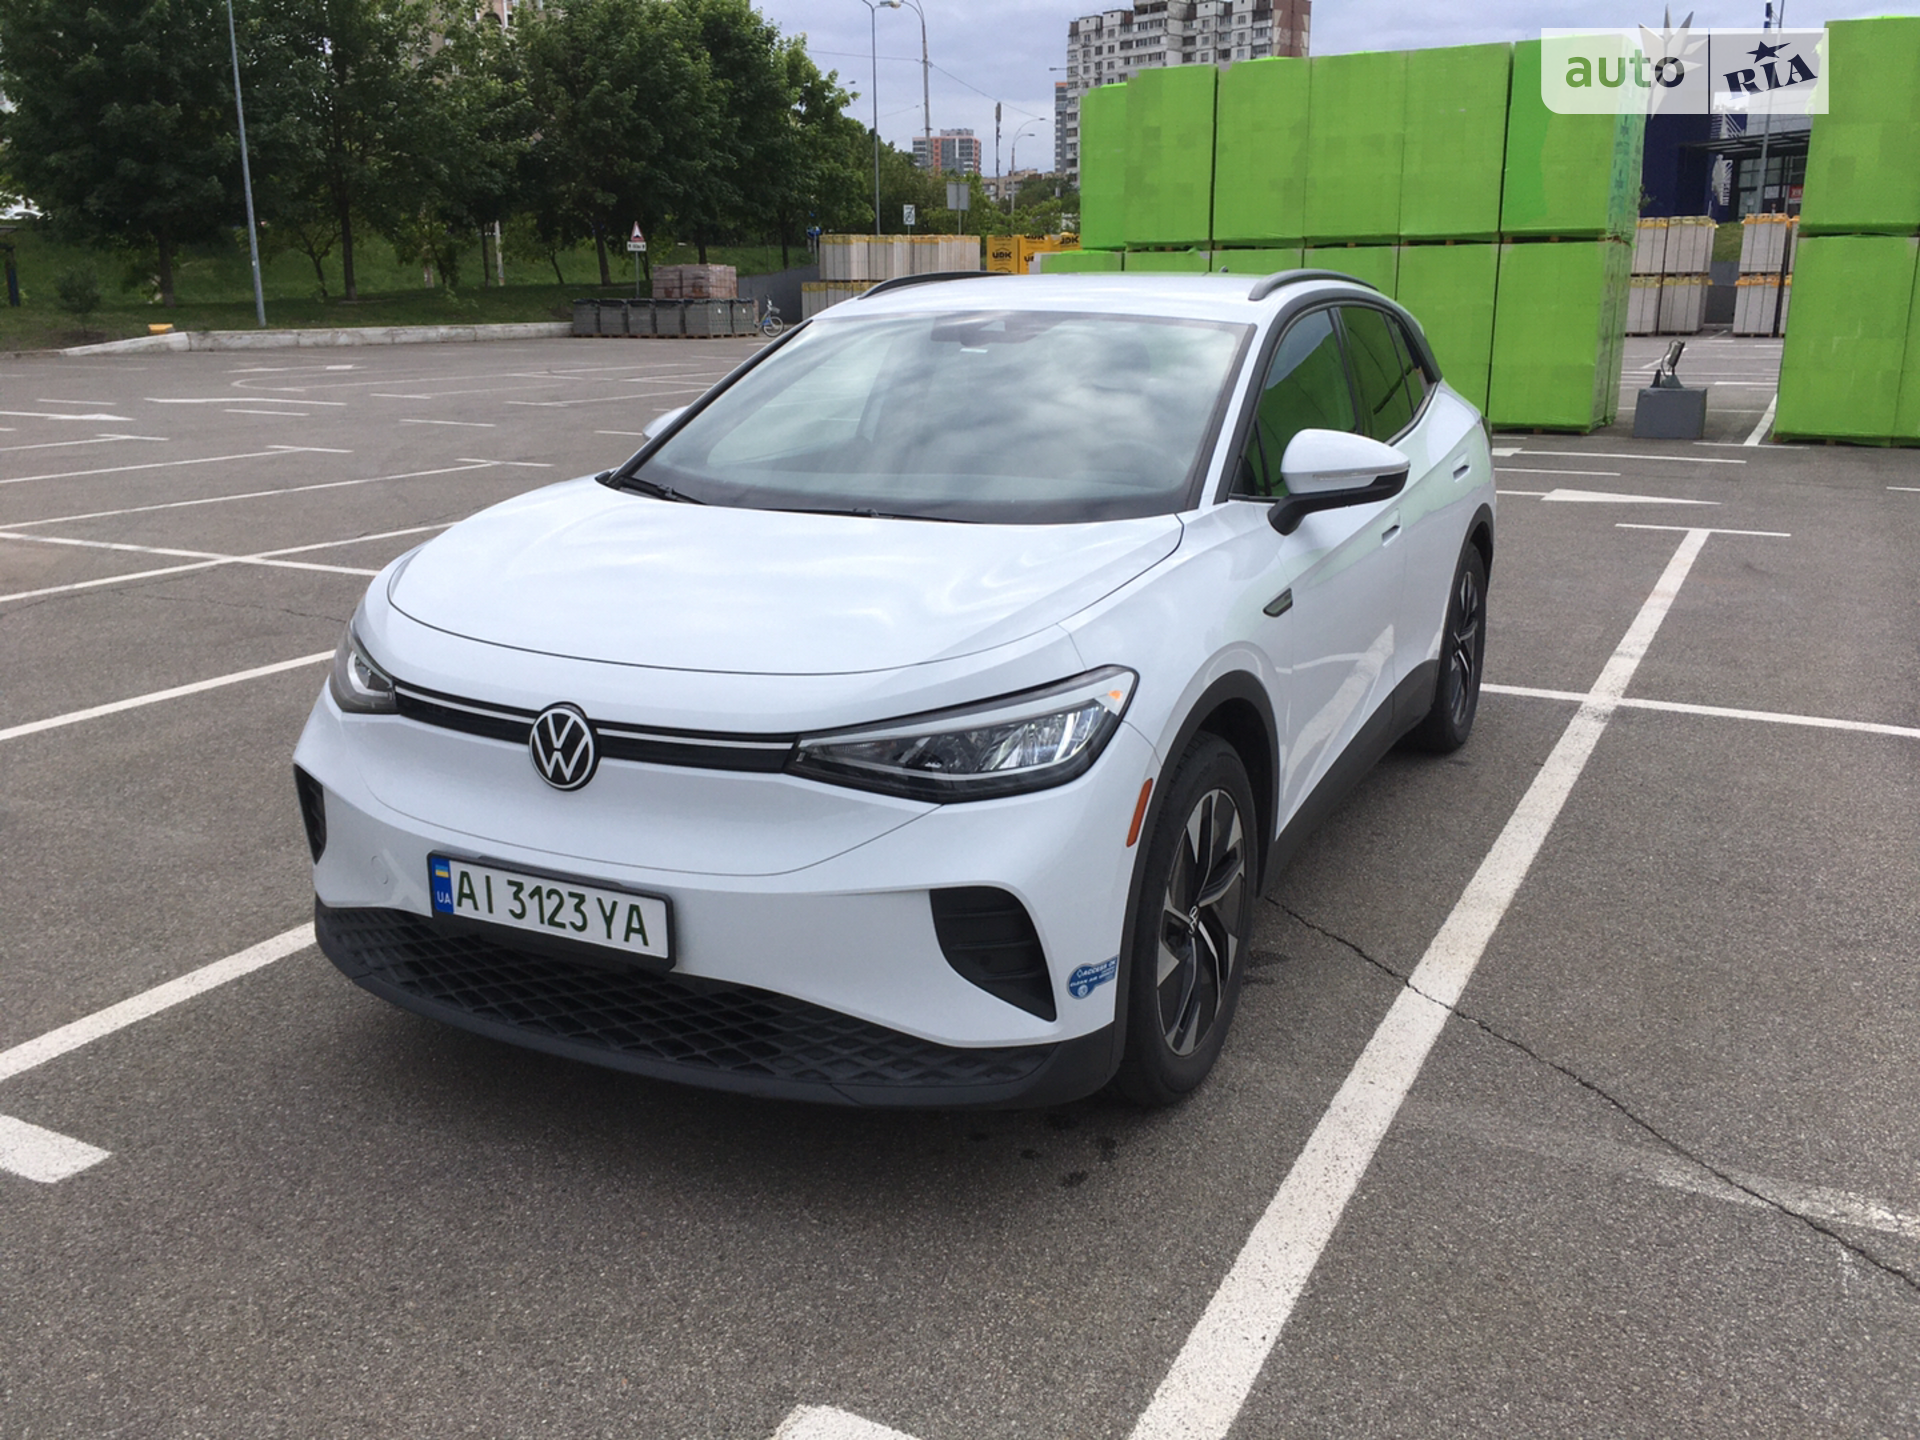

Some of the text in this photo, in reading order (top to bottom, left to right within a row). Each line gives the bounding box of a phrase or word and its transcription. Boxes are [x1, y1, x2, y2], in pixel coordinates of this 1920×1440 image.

[992, 251, 1012, 259] UDK
[437, 890, 452, 905] UA
[457, 871, 649, 946] AI 3123 YA
